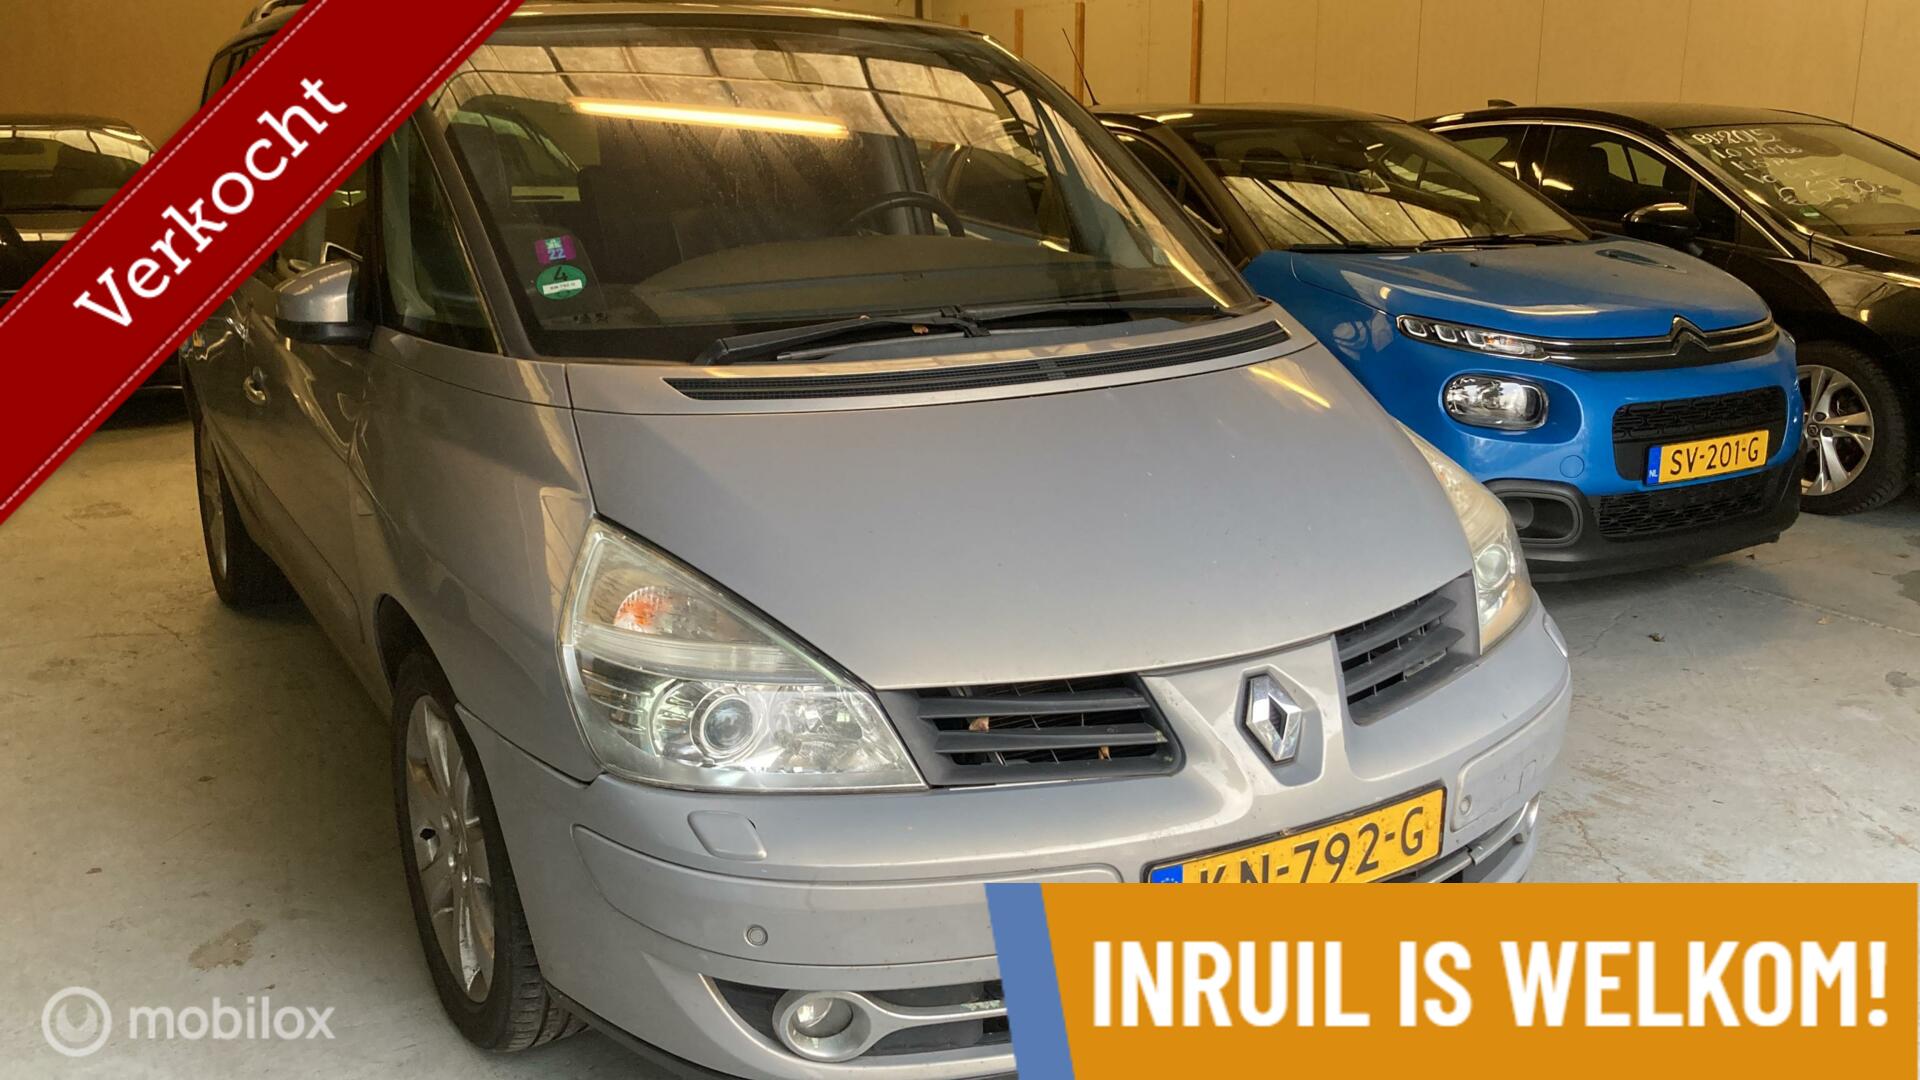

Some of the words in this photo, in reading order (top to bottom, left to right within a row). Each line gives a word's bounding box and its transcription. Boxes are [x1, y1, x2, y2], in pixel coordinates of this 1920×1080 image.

[554, 266, 569, 282] 4
[1670, 437, 1759, 475] SV-201-G
[1648, 469, 1658, 478] NL
